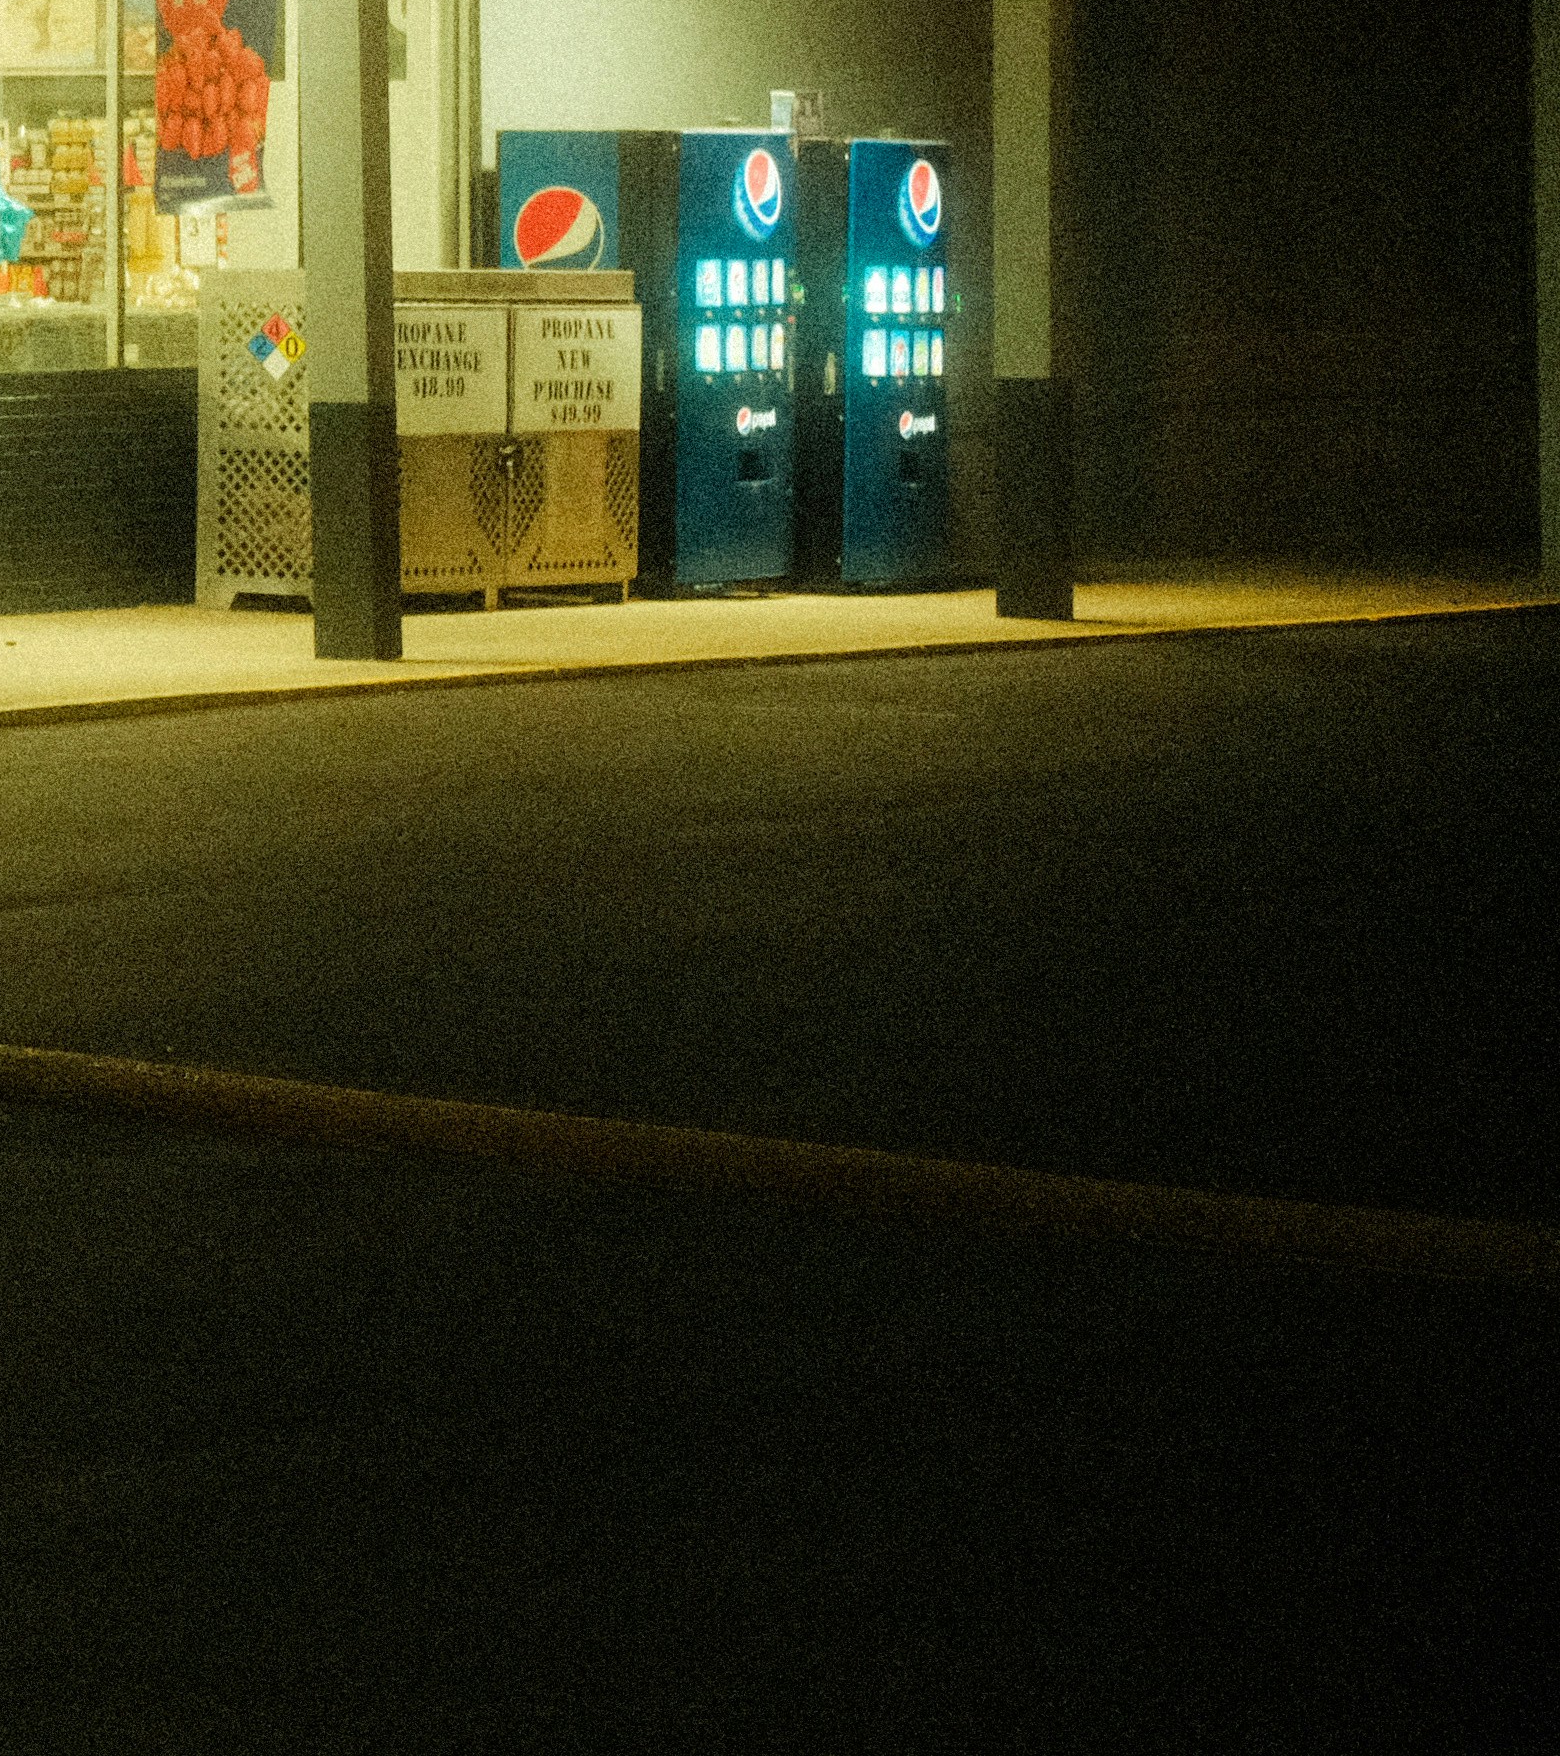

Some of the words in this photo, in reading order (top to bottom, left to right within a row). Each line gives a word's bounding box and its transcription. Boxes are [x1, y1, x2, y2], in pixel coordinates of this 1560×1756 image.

[396, 322, 467, 344] ROPANE
[542, 317, 615, 340] PROPANE
[285, 338, 298, 358] 0
[396, 348, 482, 373] EXCHANGE
[557, 349, 592, 371] NEW
